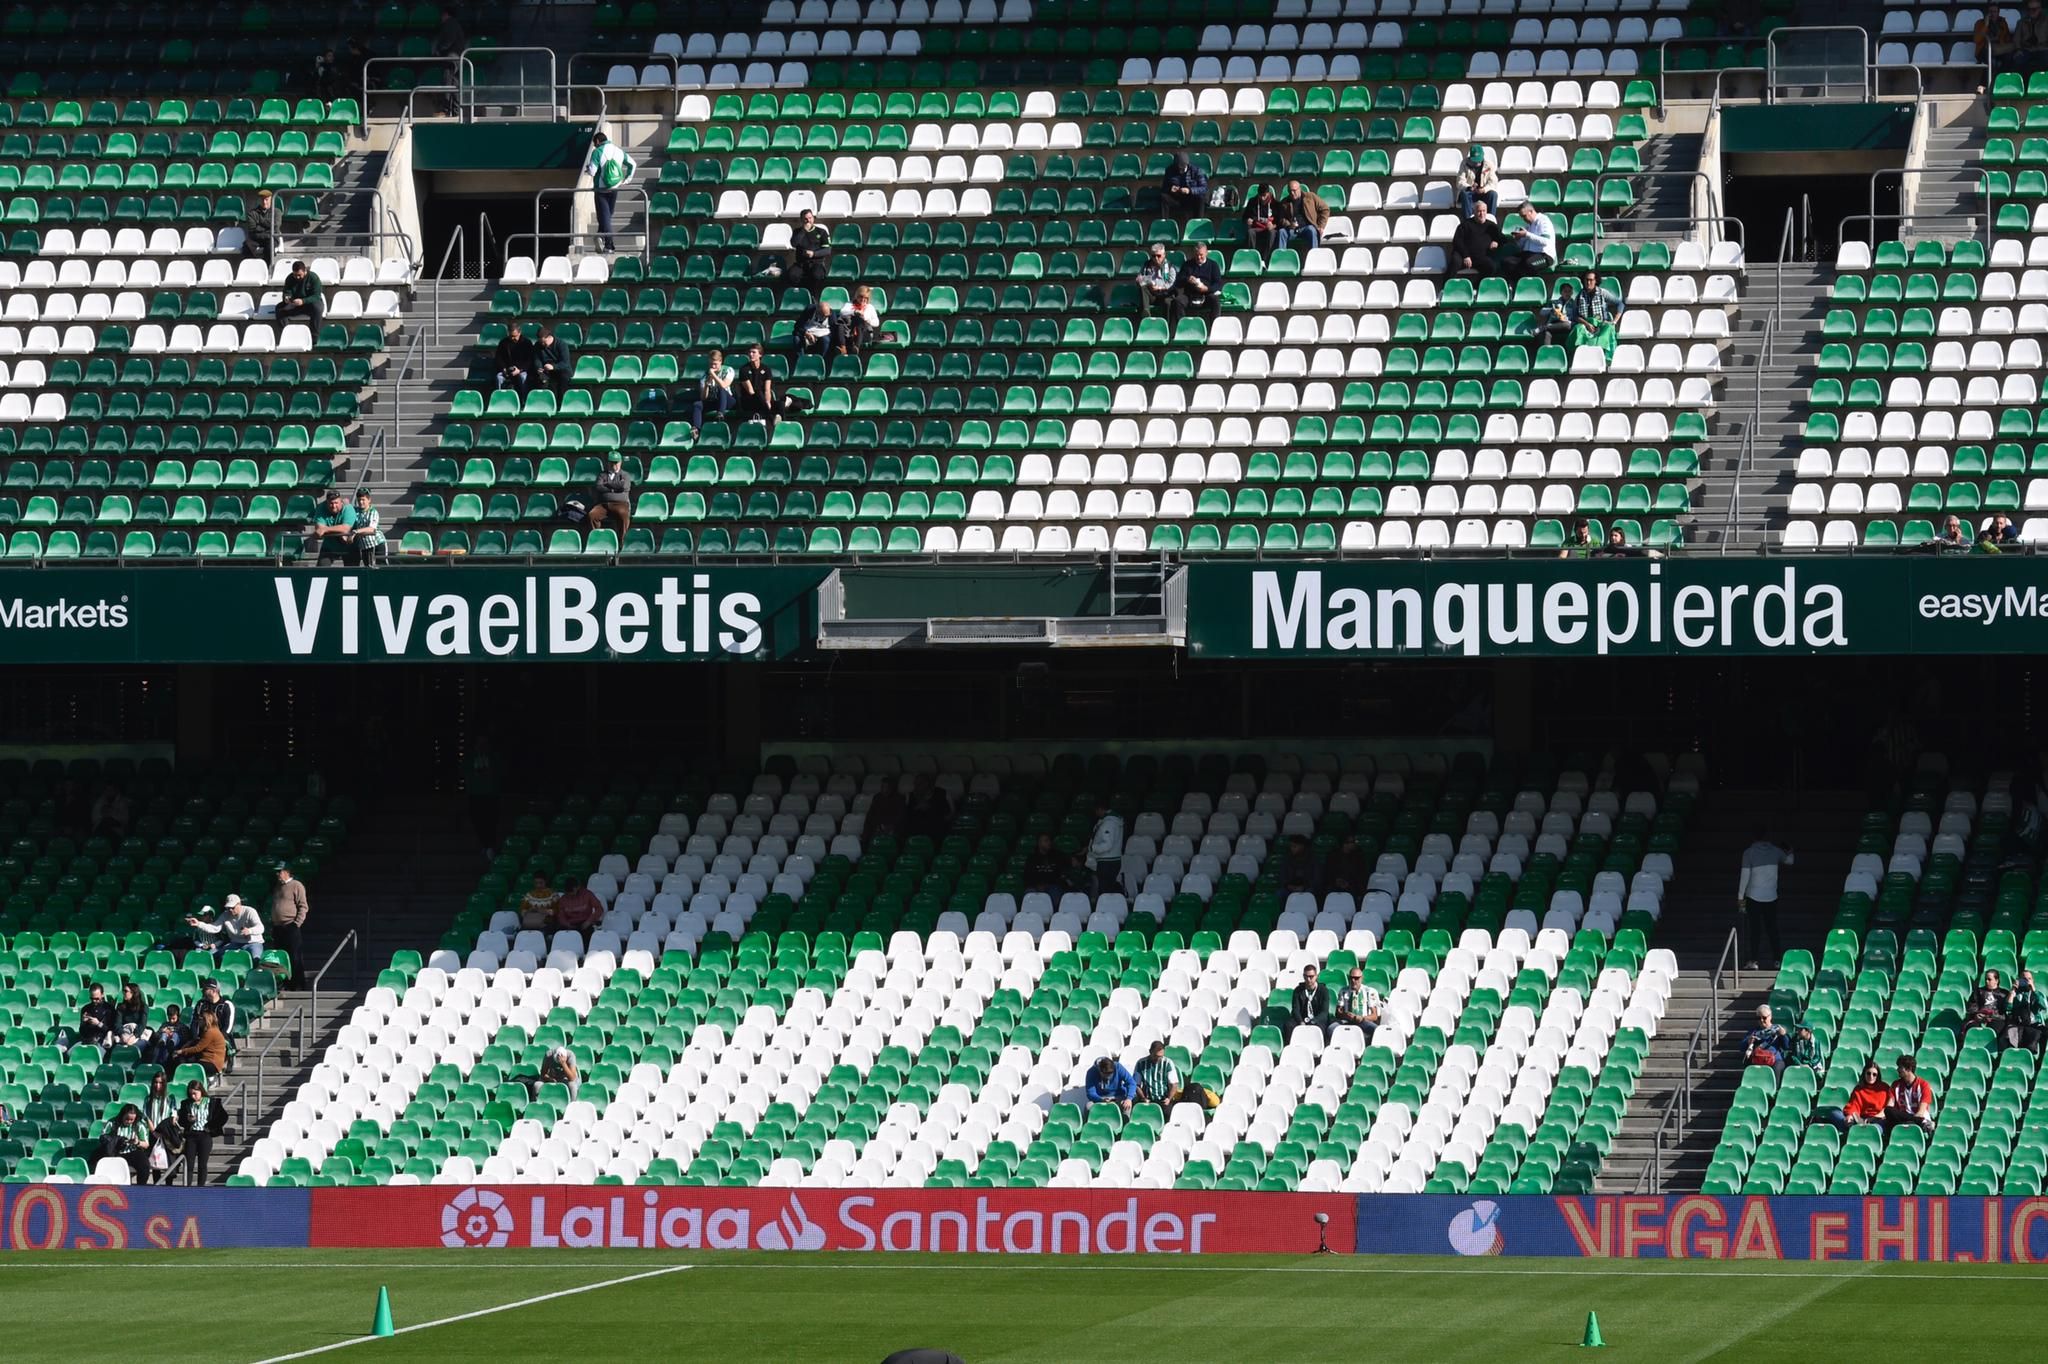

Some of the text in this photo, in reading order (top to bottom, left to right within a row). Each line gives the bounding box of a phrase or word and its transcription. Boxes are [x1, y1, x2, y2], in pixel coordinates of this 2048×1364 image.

[1252, 564, 1848, 656] Manquepierda
[0, 1185, 129, 1249] OS
[530, 1189, 1217, 1254] LaLiga Santander
